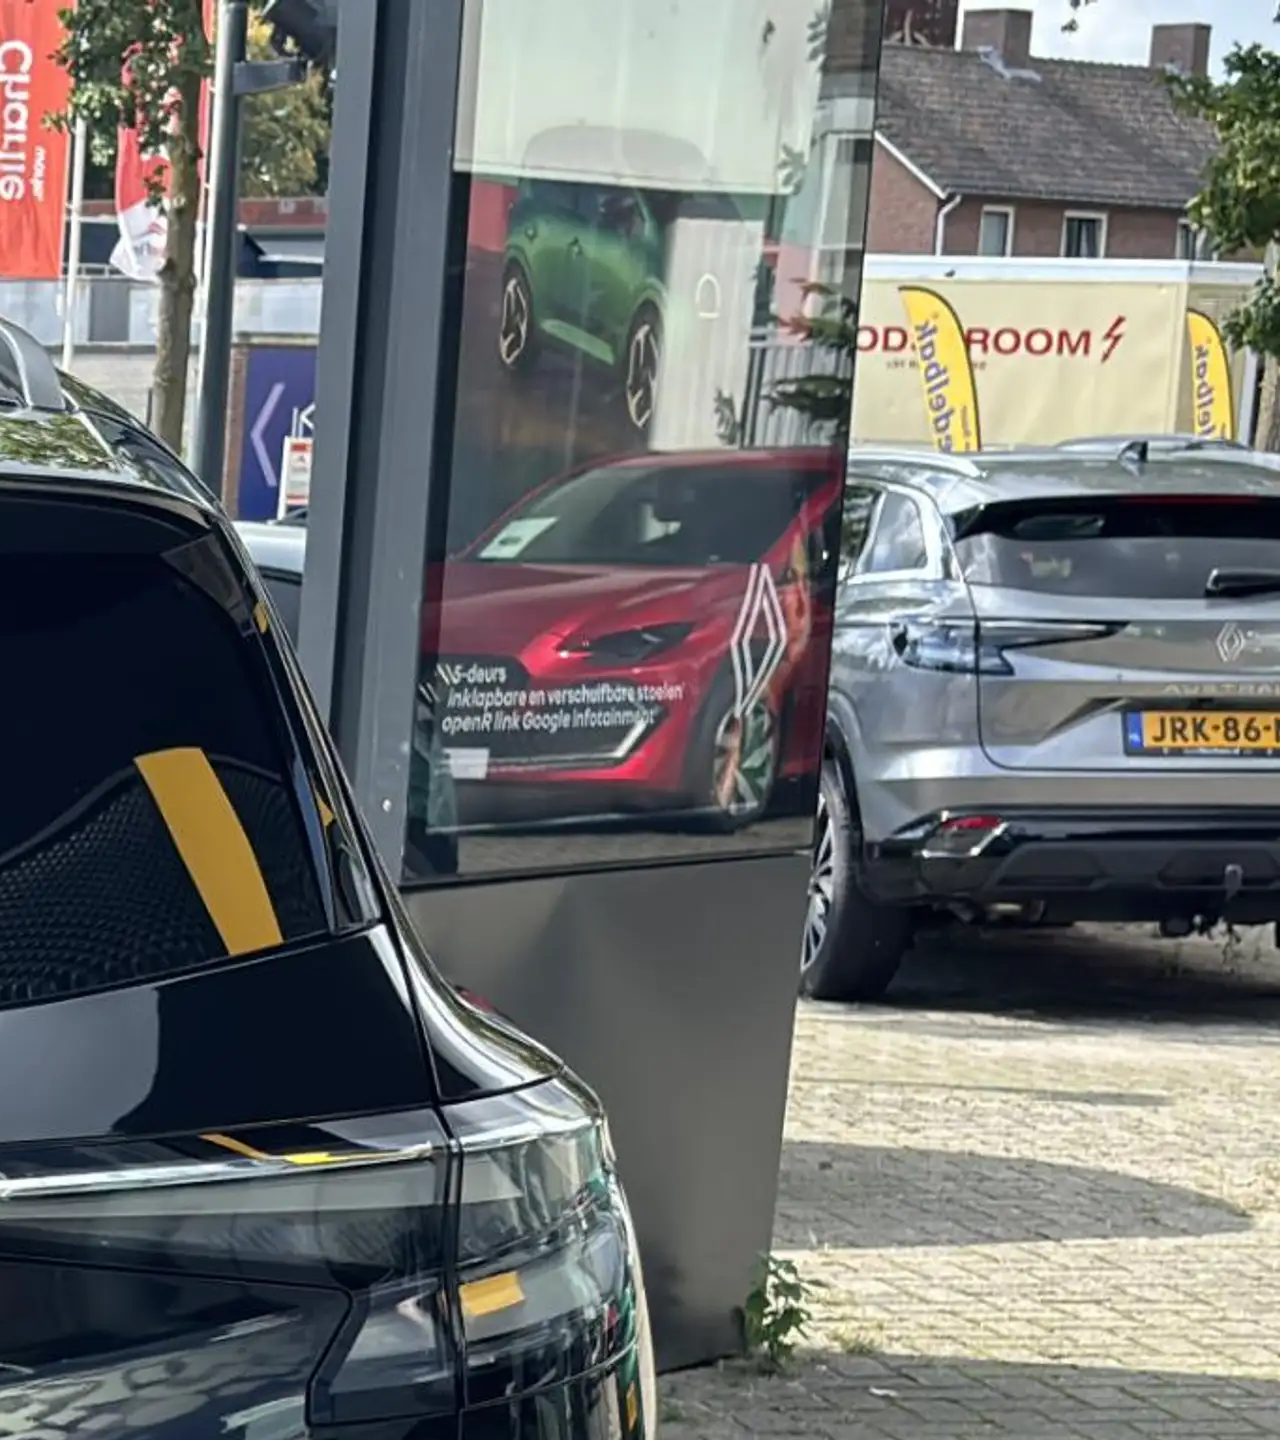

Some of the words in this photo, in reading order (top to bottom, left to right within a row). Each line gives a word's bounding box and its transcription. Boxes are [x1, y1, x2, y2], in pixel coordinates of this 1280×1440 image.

[447, 687, 526, 712] inklapbare
[528, 690, 546, 706] en
[493, 711, 521, 732] link
[522, 709, 570, 735] Google
